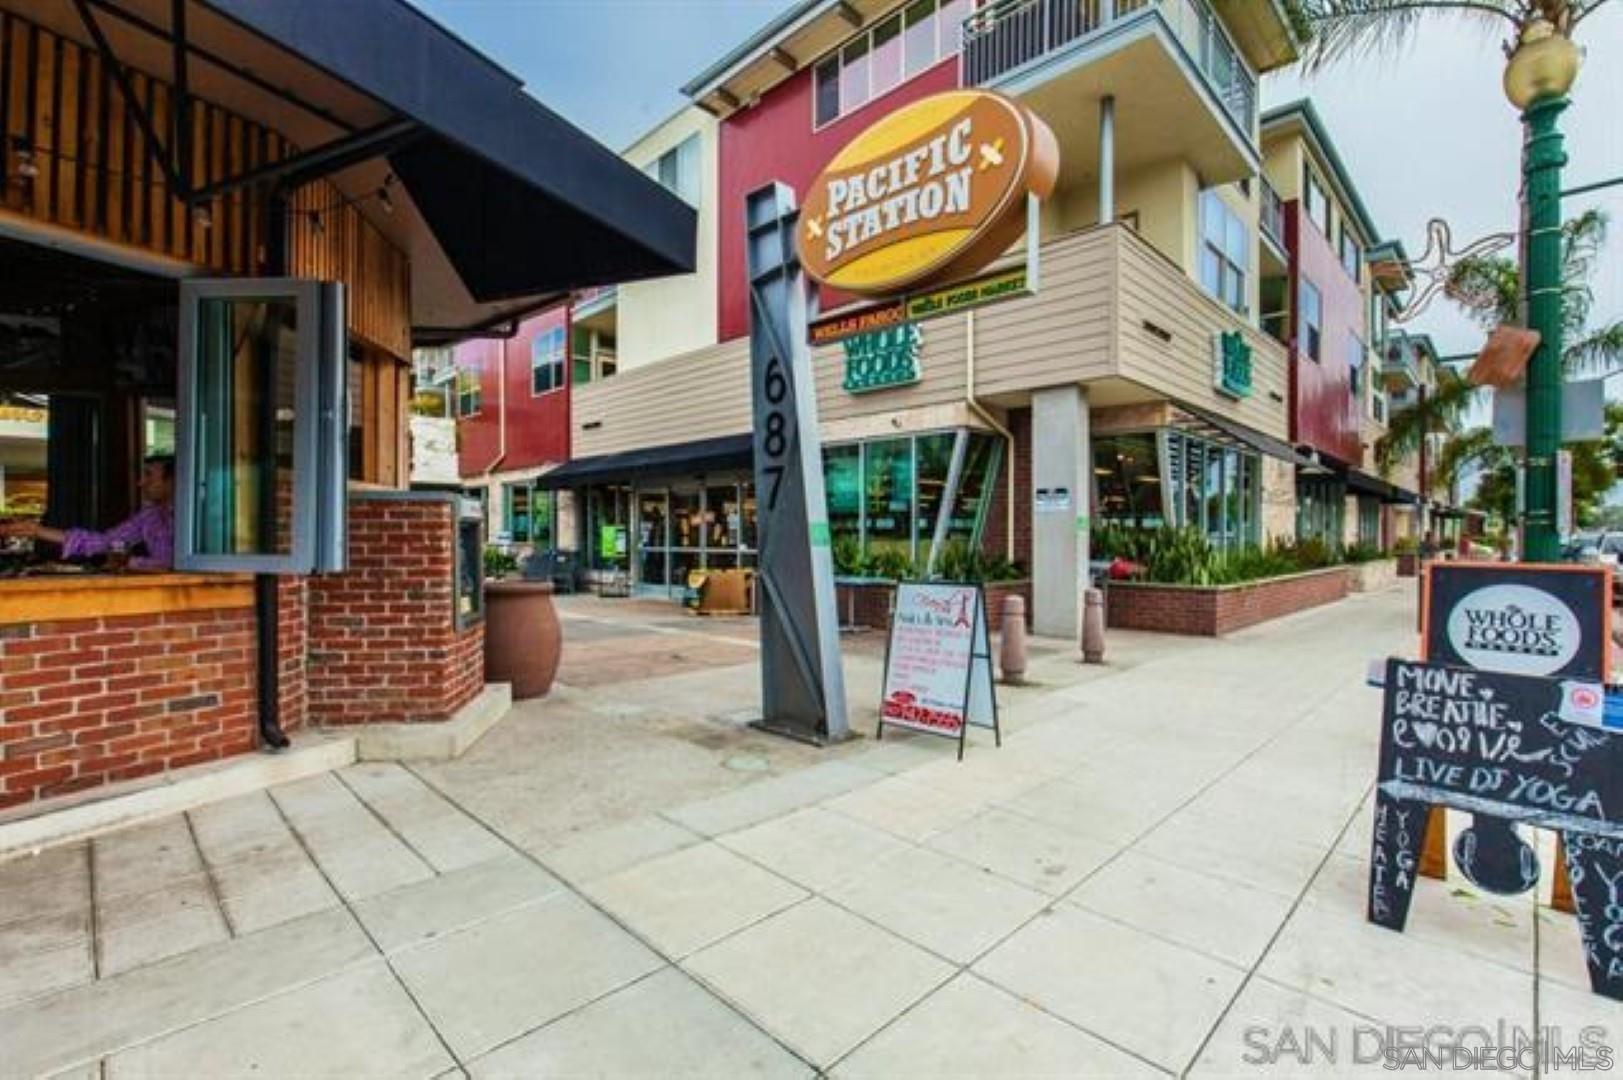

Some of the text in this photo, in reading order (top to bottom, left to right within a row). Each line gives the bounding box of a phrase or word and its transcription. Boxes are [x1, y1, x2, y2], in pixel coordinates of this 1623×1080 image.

[825, 117, 973, 217] PACIFIC
[825, 166, 973, 261] STATION
[763, 357, 787, 513] 687
[1463, 607, 1563, 633] WHOLE
[1468, 625, 1559, 651] FOODS
[1395, 757, 1606, 822] LIVE DJ YOGA
[1395, 809, 1414, 891] YOGA
